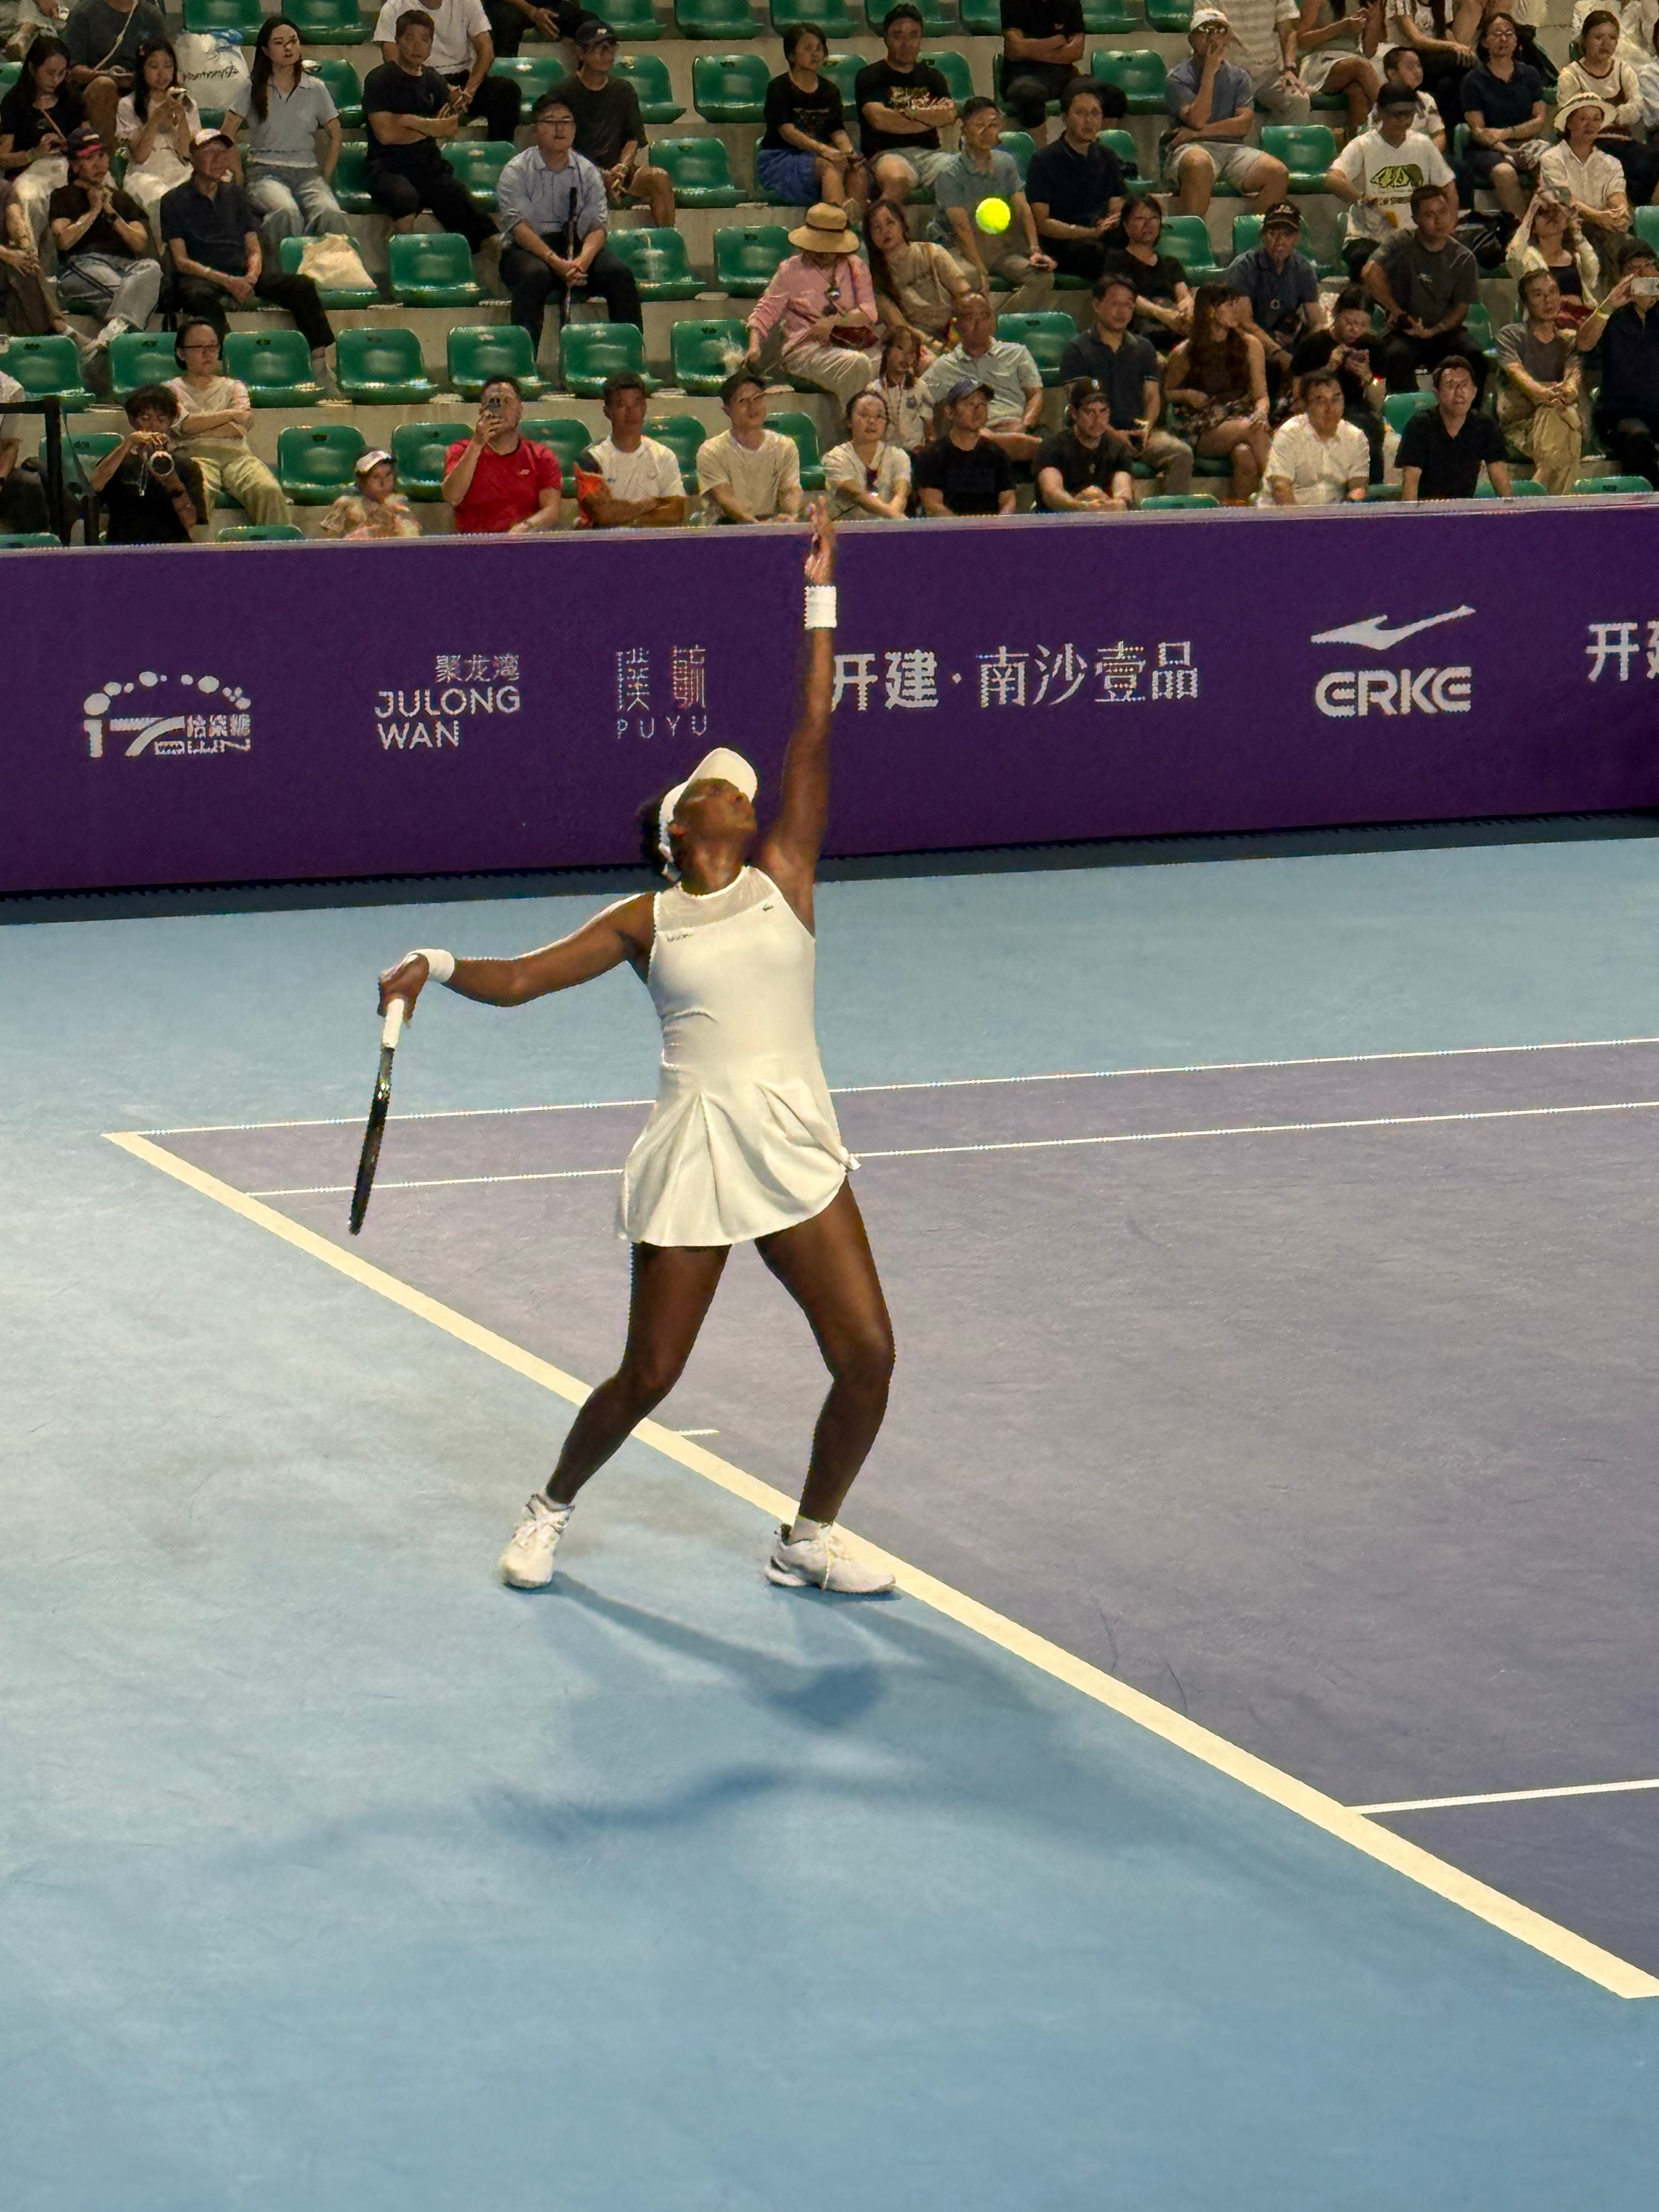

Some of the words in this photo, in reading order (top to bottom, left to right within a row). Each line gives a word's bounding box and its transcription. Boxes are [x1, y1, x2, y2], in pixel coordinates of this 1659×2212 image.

[1584, 620, 1659, 682] 开
[374, 686, 520, 718] JULONG
[1316, 666, 1471, 718] ERKE
[377, 720, 460, 751] WAN
[617, 715, 707, 739] PUYU
